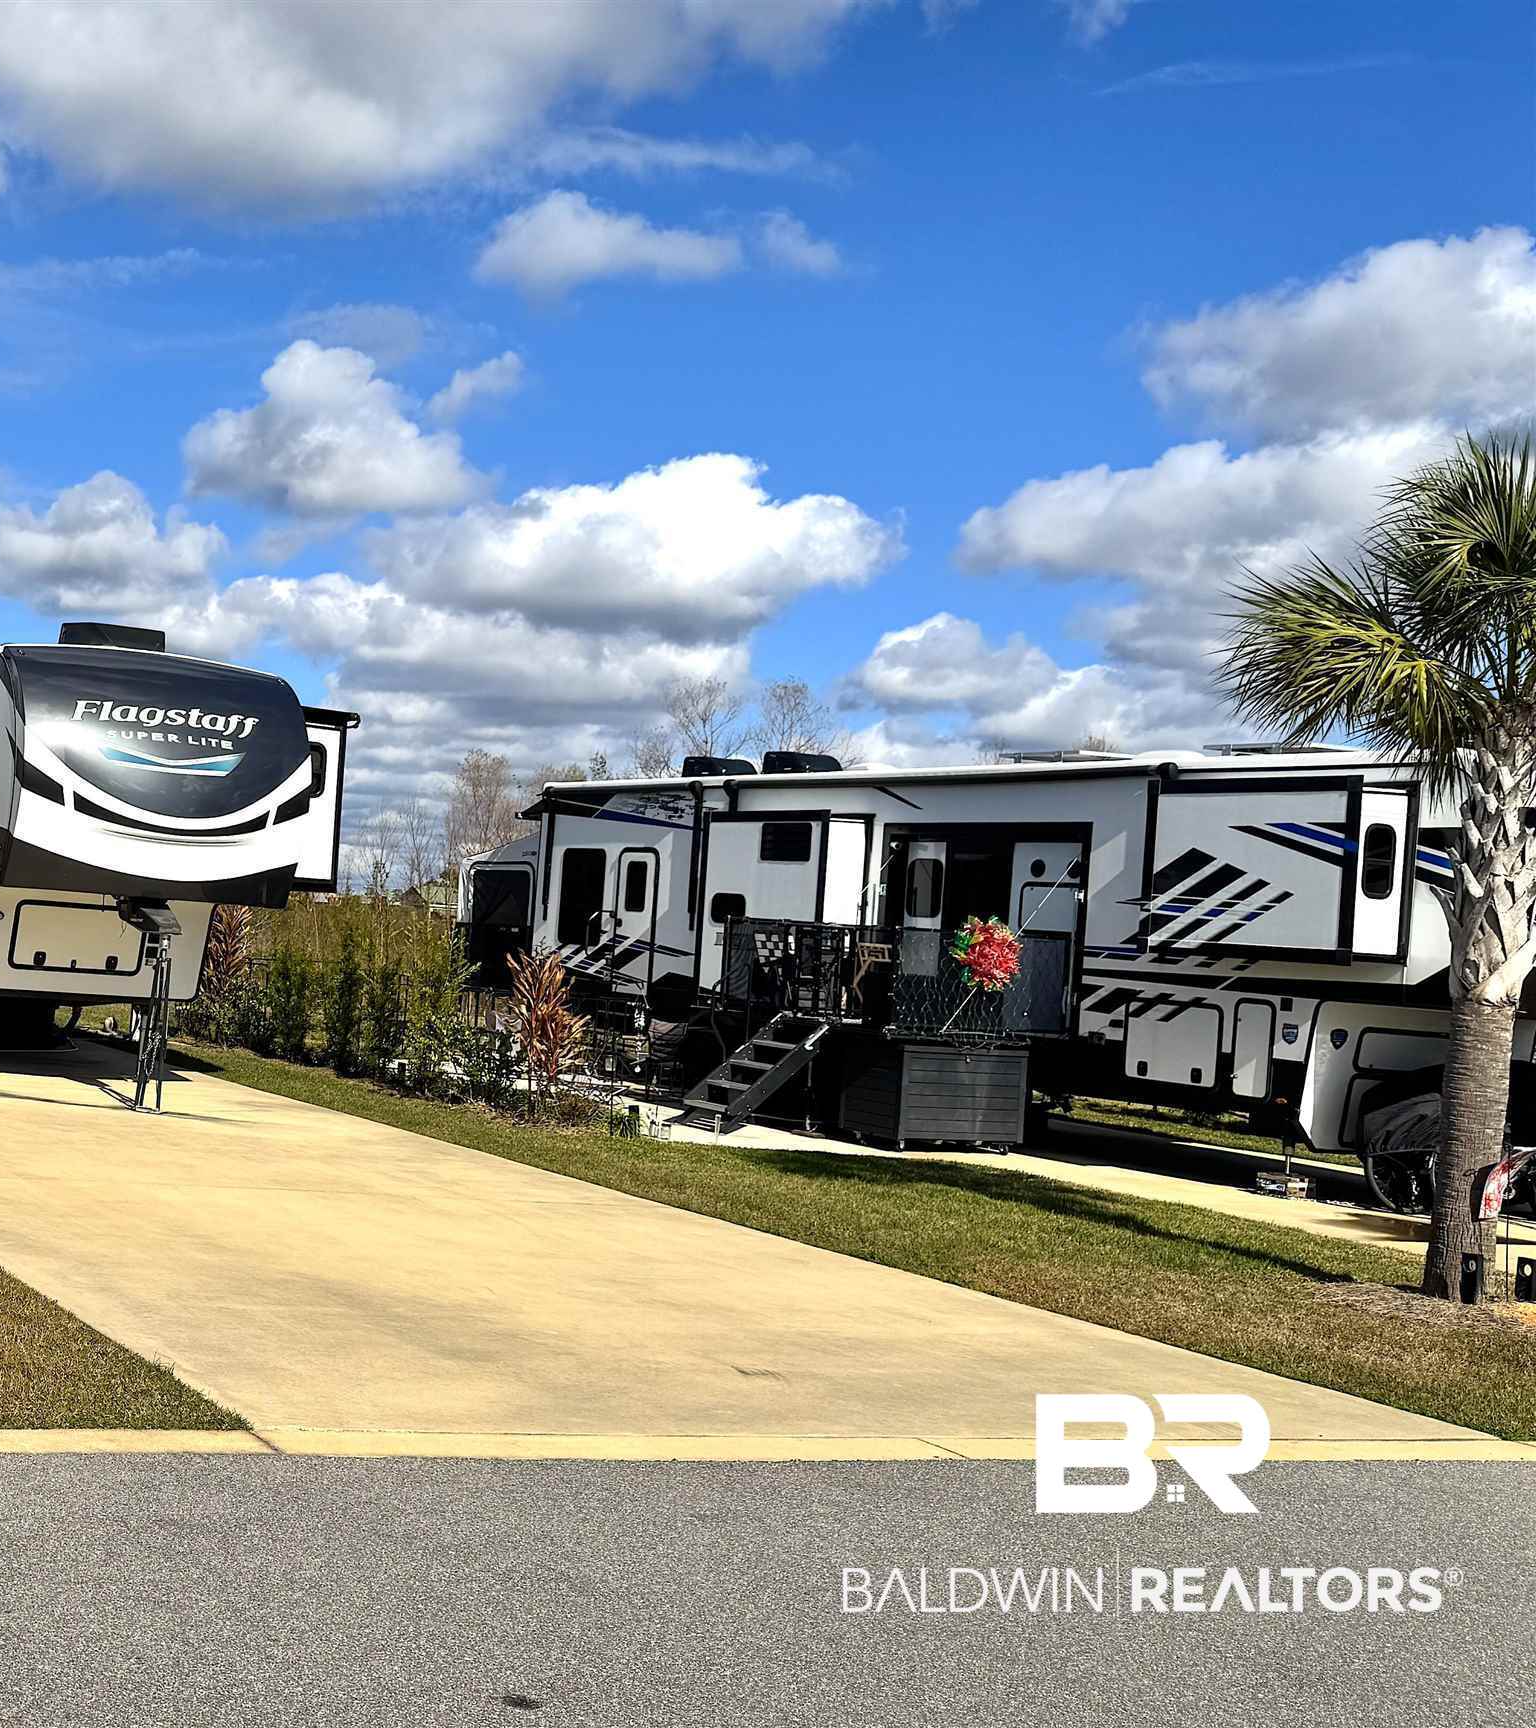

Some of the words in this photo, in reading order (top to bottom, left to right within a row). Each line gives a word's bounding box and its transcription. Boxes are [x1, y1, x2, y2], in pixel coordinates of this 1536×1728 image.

[70, 699, 260, 739] Flagstaff
[106, 729, 182, 744] SUPER
[187, 734, 234, 750] LITE
